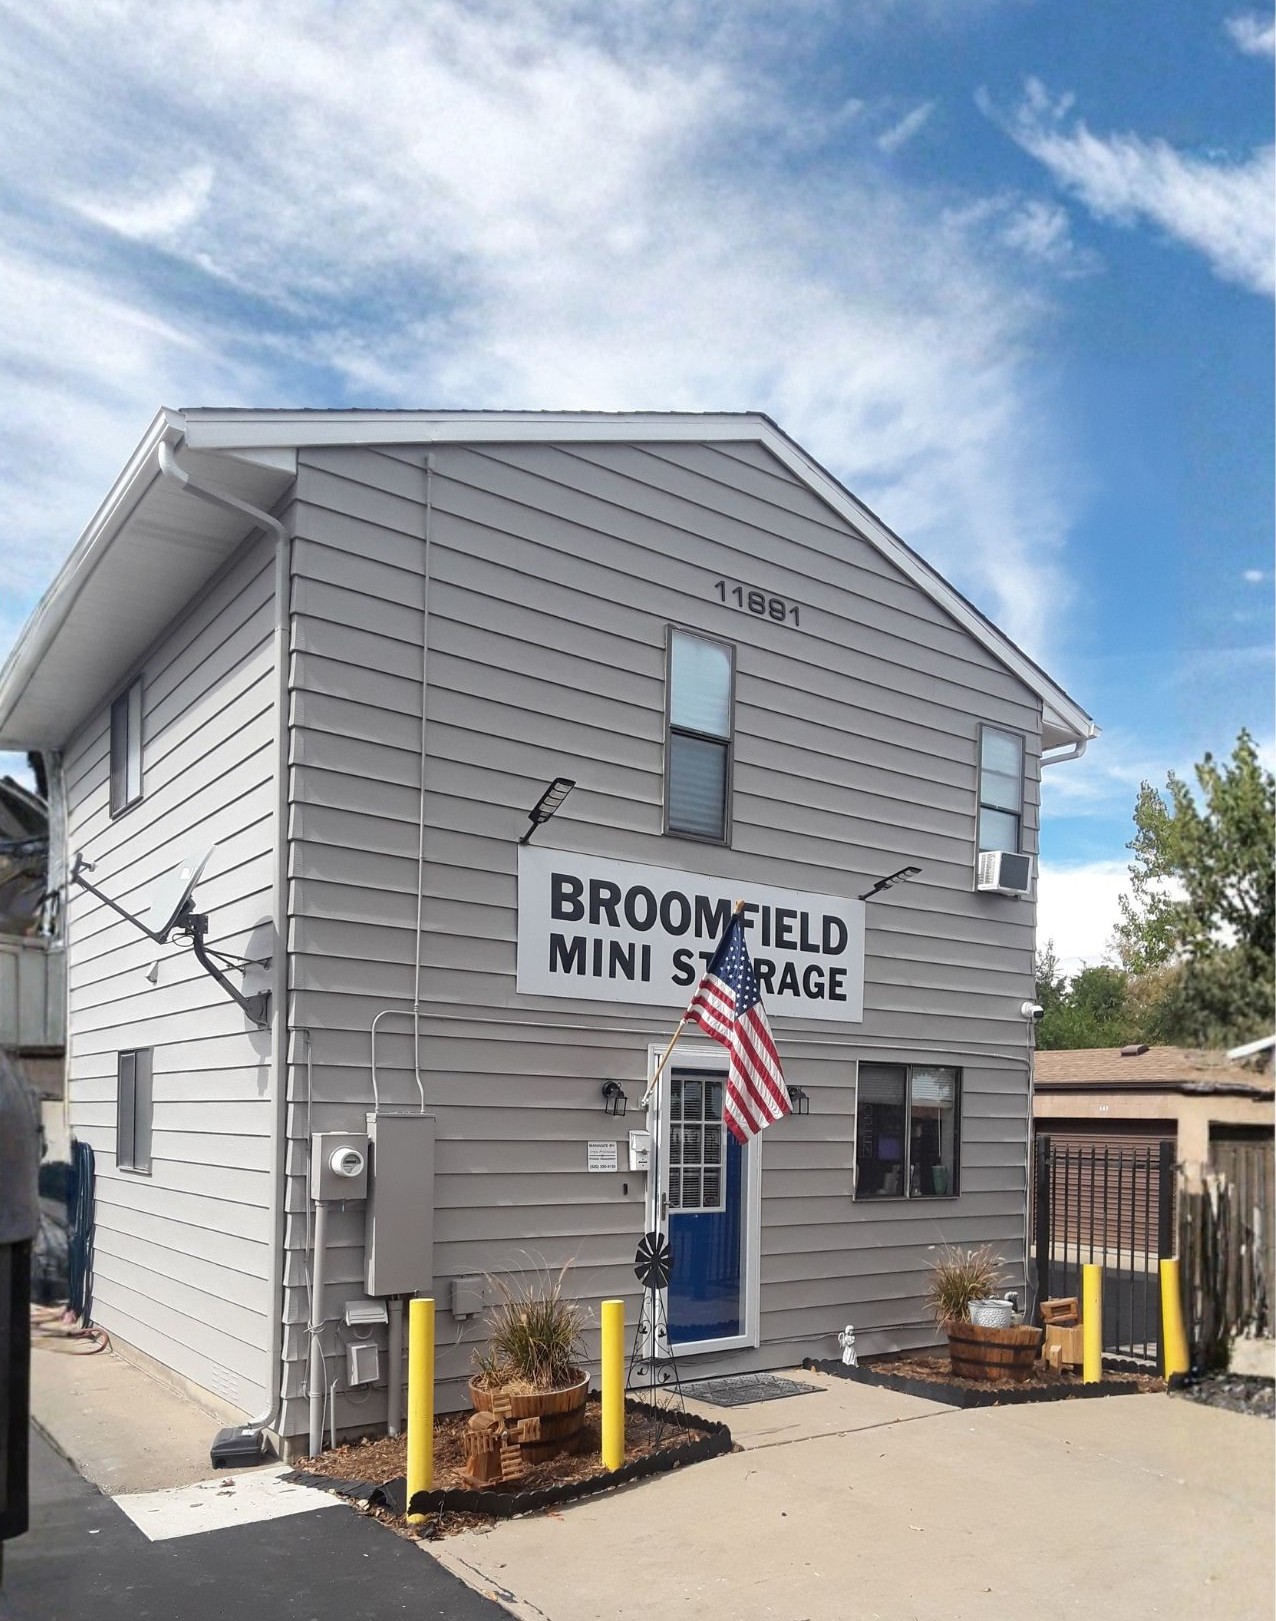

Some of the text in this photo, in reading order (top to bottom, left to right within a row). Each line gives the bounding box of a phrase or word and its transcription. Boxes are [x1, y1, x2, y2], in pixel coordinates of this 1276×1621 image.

[714, 580, 800, 627] 11891
[550, 872, 848, 956] BROOMFIELD
[549, 932, 848, 1001] MINI SRAGE
